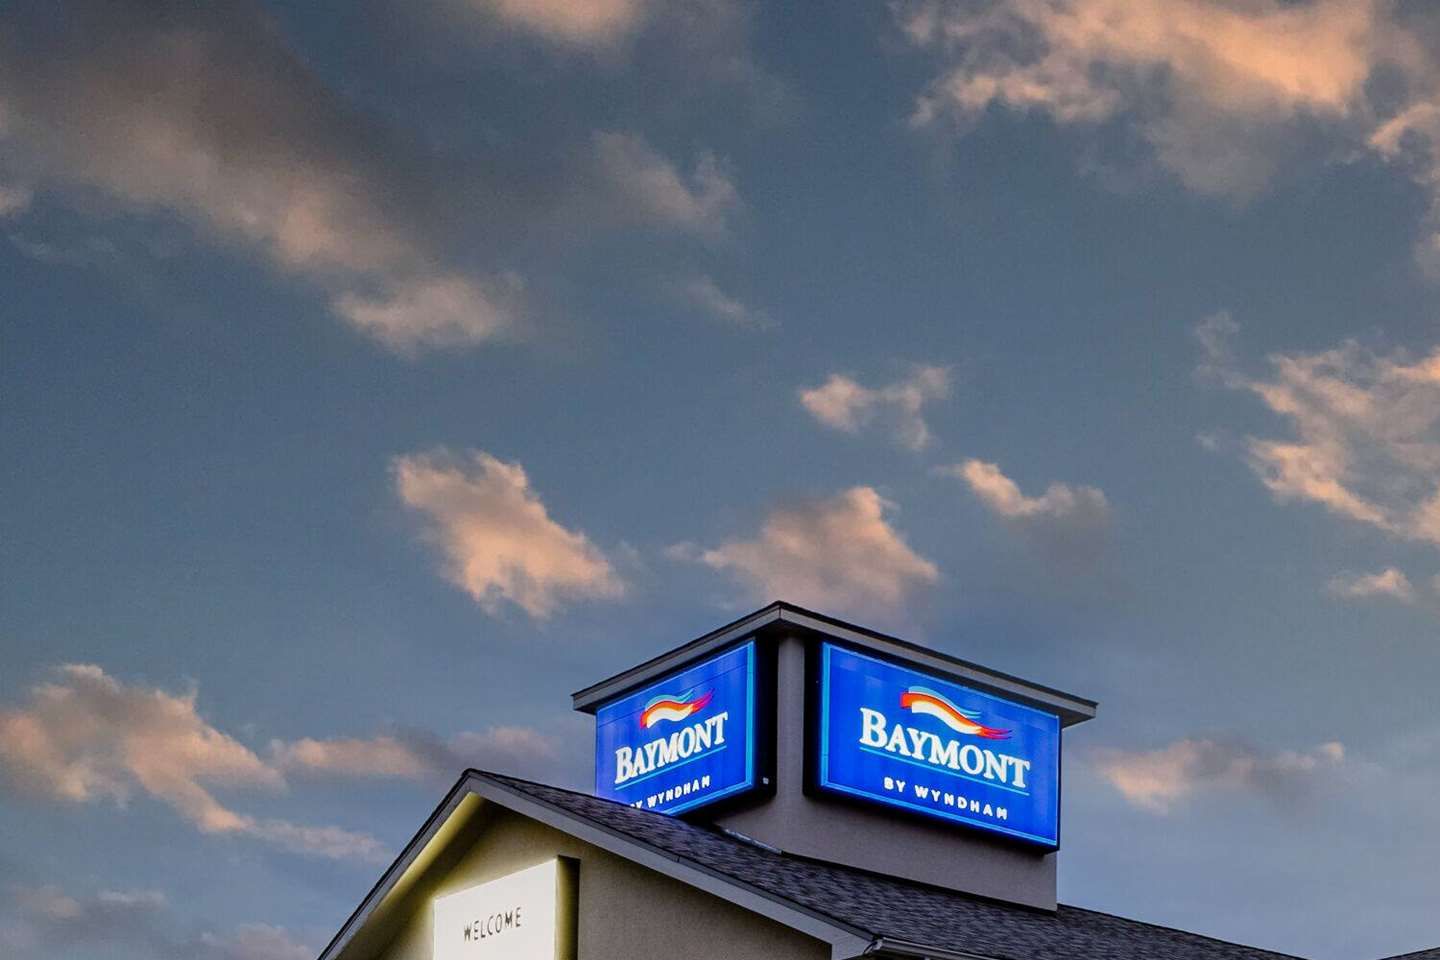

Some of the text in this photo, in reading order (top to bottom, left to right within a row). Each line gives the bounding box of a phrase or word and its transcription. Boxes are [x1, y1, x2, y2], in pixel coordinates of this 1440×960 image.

[614, 711, 729, 785] BAYMONT
[859, 707, 1031, 788] BAYMONT
[647, 775, 711, 808] WYNDHAM
[883, 776, 1008, 820] BY WYNDHAM
[463, 906, 522, 942] WELCOME
